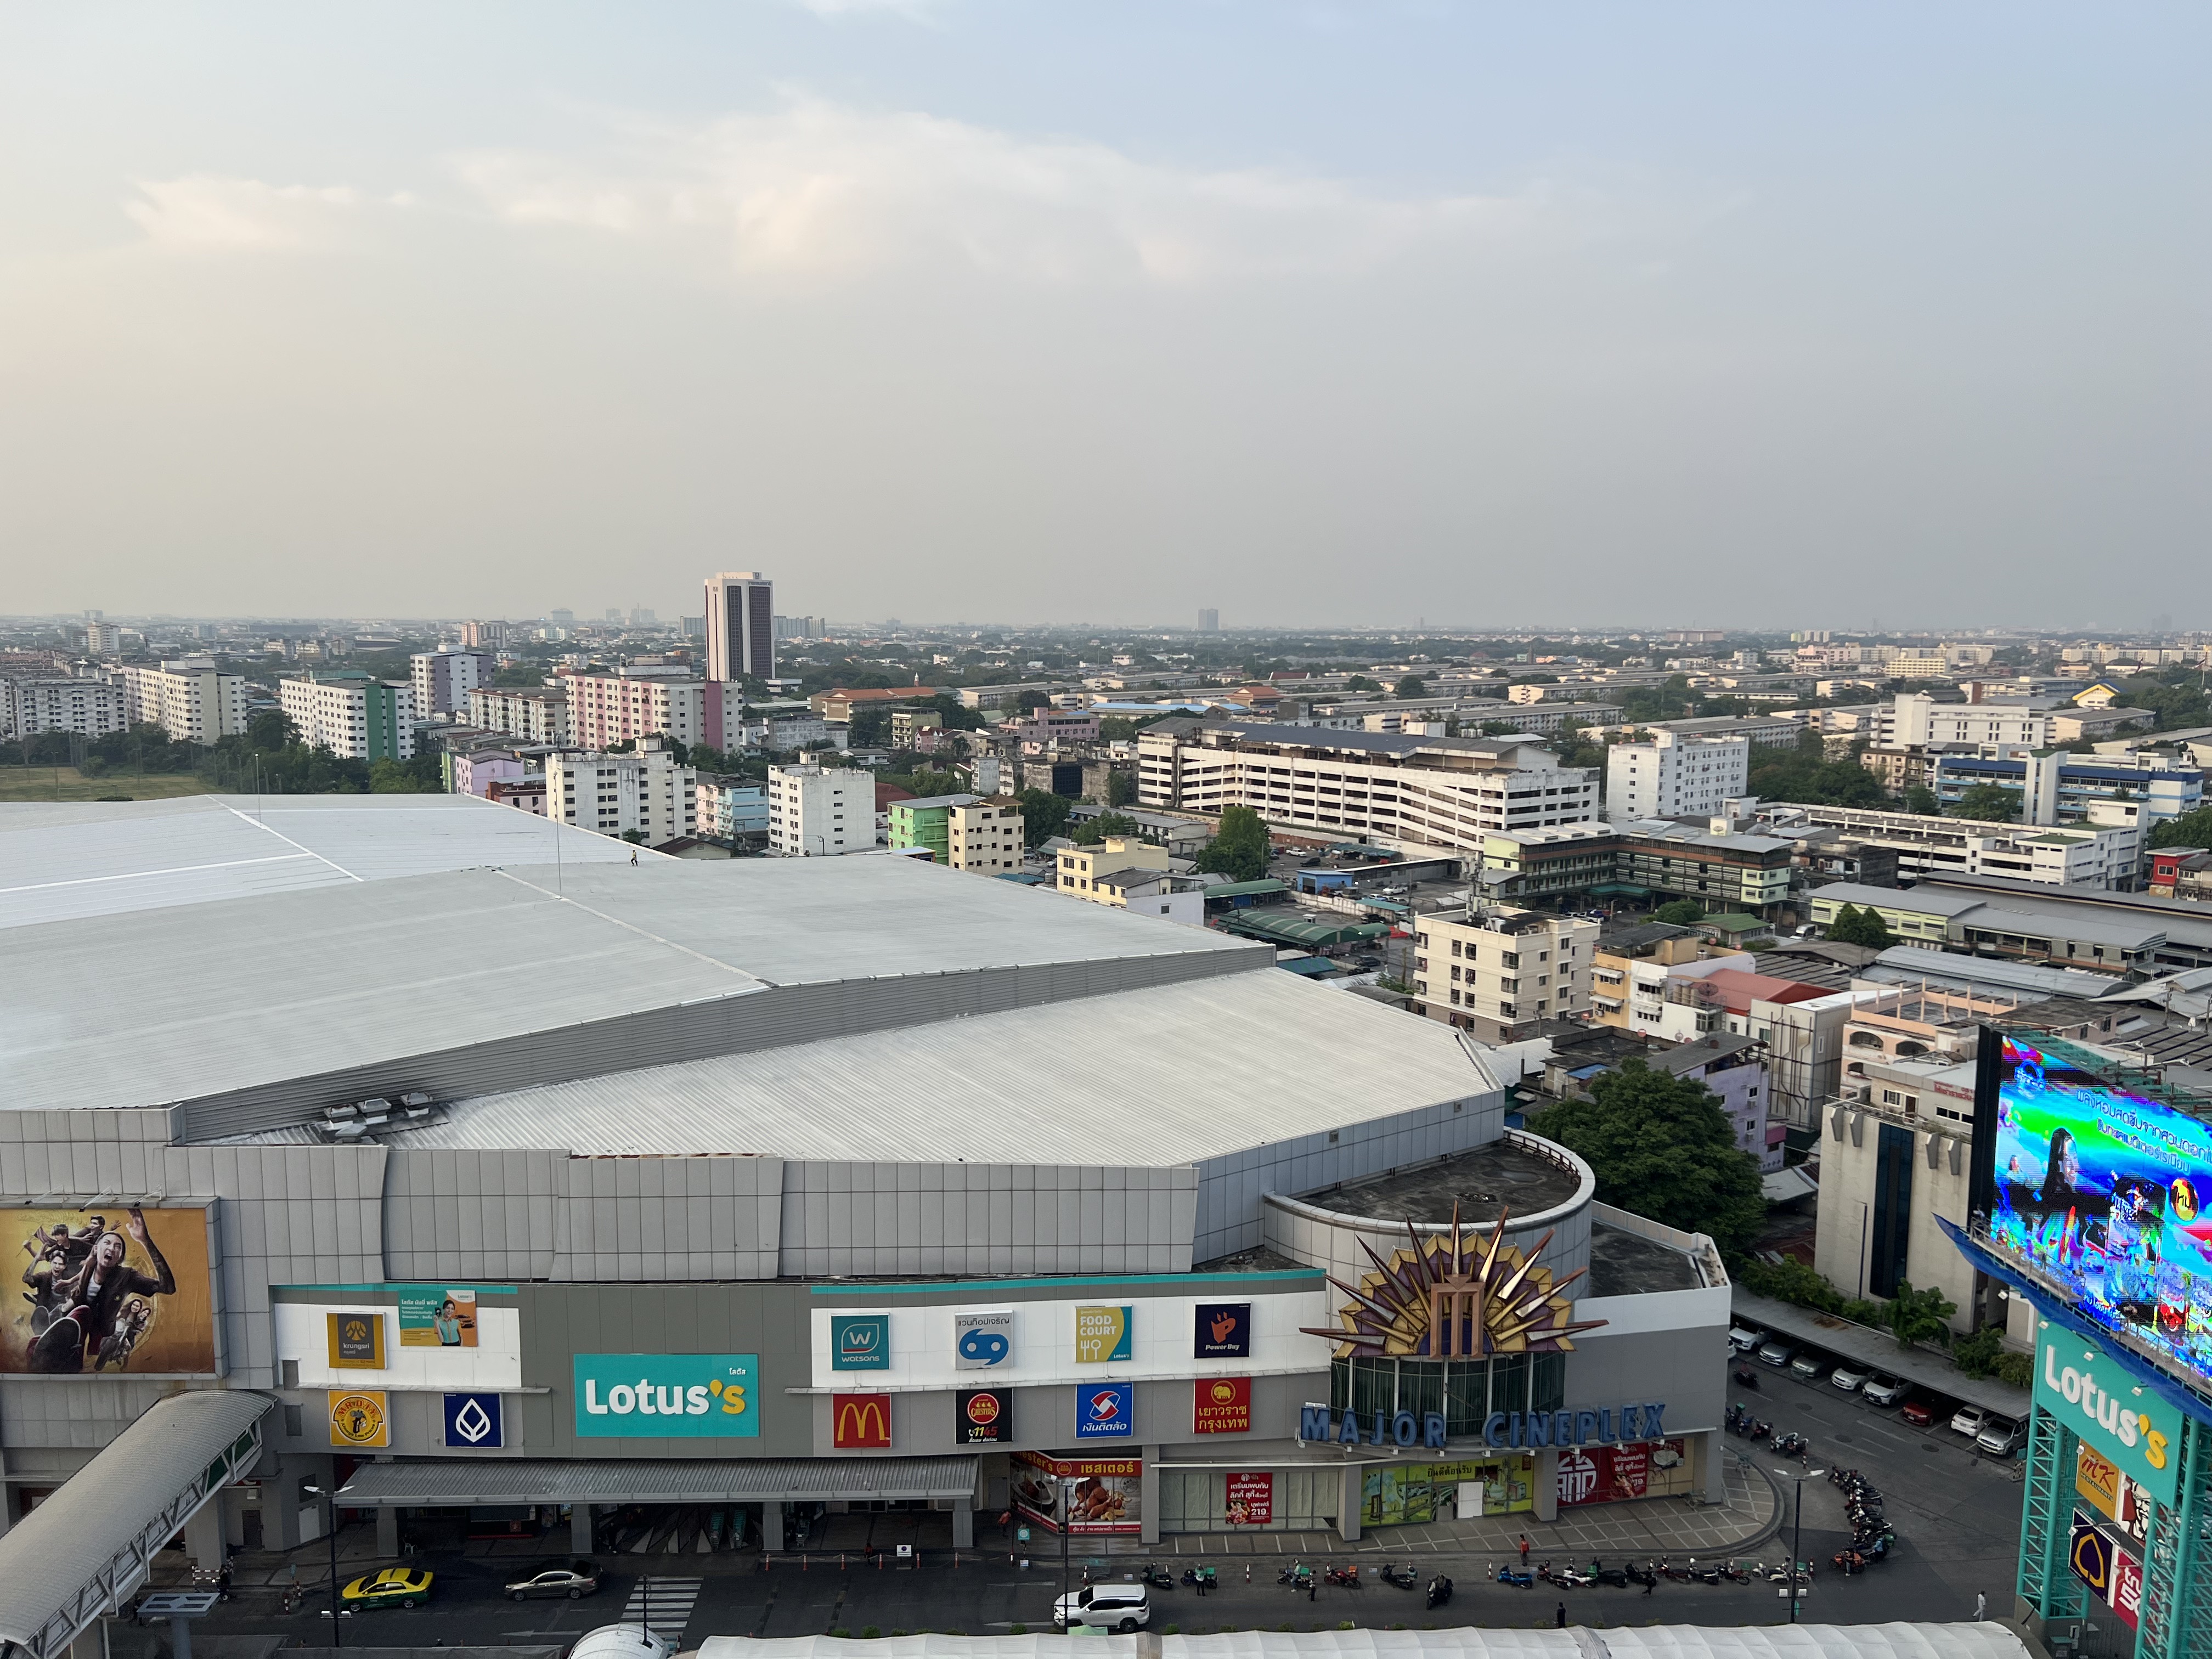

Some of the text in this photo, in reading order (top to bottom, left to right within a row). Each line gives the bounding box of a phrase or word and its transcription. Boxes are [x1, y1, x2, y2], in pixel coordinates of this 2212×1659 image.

[958, 1317, 1009, 1326] แว่นท็อปเจริญ
[1080, 1315, 1112, 1325] FOOD
[1080, 1326, 1116, 1335] COURT
[585, 1379, 746, 1415] Lotus's
[1199, 1405, 1247, 1417] เยาวราช
[2045, 1345, 2168, 1469] Lotus's
[1082, 1421, 1127, 1432] เงินติดล้อ
[1199, 1418, 1248, 1434] กรุงเทพ
[1300, 1401, 1666, 1448] MAJOR CINEPLEX
[974, 1426, 997, 1436] 1145
[1081, 1461, 1135, 1474] เชสเตอร์
[1427, 1465, 1472, 1477] ยินดีต้อนรับ
[2082, 1455, 2115, 1493] MK
[2080, 1471, 2114, 1502] RESTAURANTS
[1245, 1489, 1255, 1499] สุกี้
